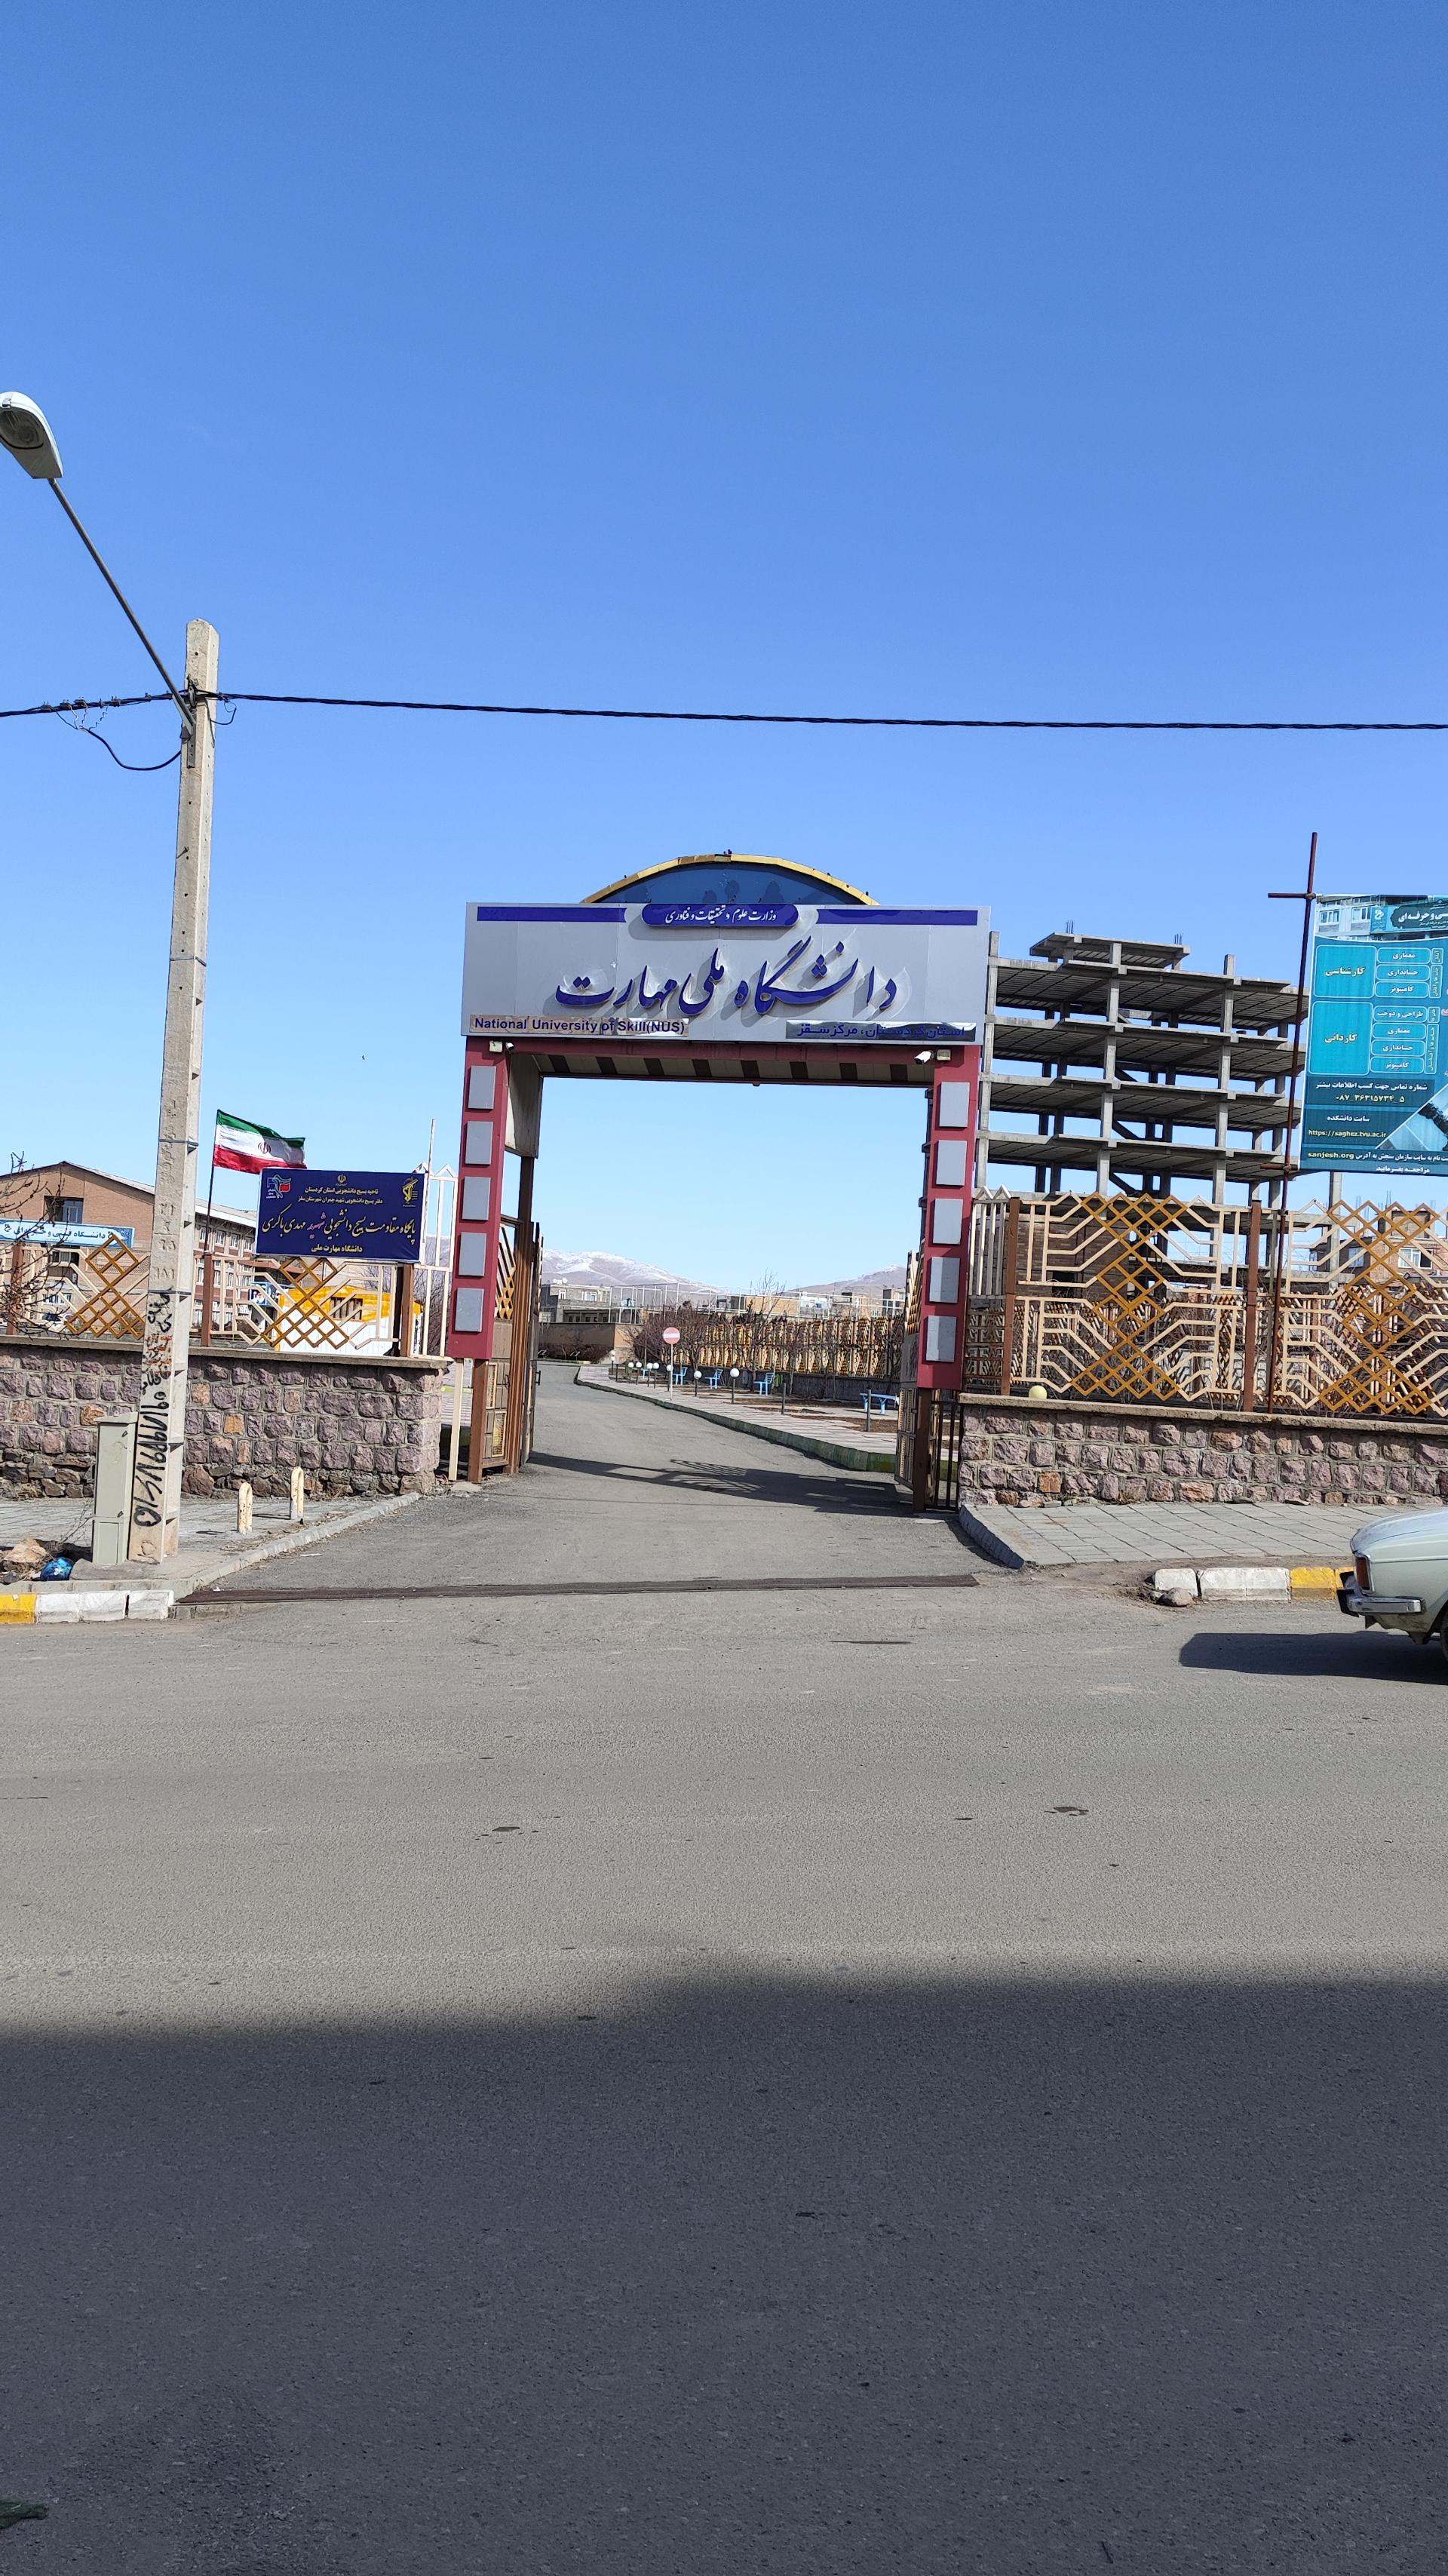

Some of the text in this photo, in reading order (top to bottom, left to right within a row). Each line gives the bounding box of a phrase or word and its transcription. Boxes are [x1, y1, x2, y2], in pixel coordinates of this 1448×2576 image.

[665, 904, 777, 924] وزارت علوم و تحقیقات و فناوری
[555, 935, 897, 1015] دانشگاه ملی مهارت
[1325, 967, 1365, 977] کارشناسی
[1387, 969, 1418, 977] حسابداری
[1390, 985, 1414, 993] کامپیوتر
[1401, 1010, 1424, 1018] طراحی
[474, 1018, 685, 1034] National University of Skill(NUS)
[796, 1024, 830, 1037] سقز
[830, 1024, 858, 1037] مرکز
[927, 1025, 965, 1039] استان
[1324, 1033, 1358, 1043] کاردانی
[1385, 1061, 1410, 1069] کامپیوتر
[1315, 1081, 1331, 1089] بیشتر
[1308, 1151, 1354, 1160] sanjesh.org
[1355, 1151, 1372, 1160] آدرس
[305, 1186, 324, 1194] کردستان
[283, 1218, 306, 1233] مهدی
[306, 1211, 327, 1239] شهید
[351, 1215, 367, 1238] بسیج
[365, 1217, 400, 1233] مقاومت
[74, 1230, 106, 1239] دانشگاه
[399, 1218, 416, 1245] پایگاه
[311, 1243, 363, 1253] دانشگاه مهارت ملی
